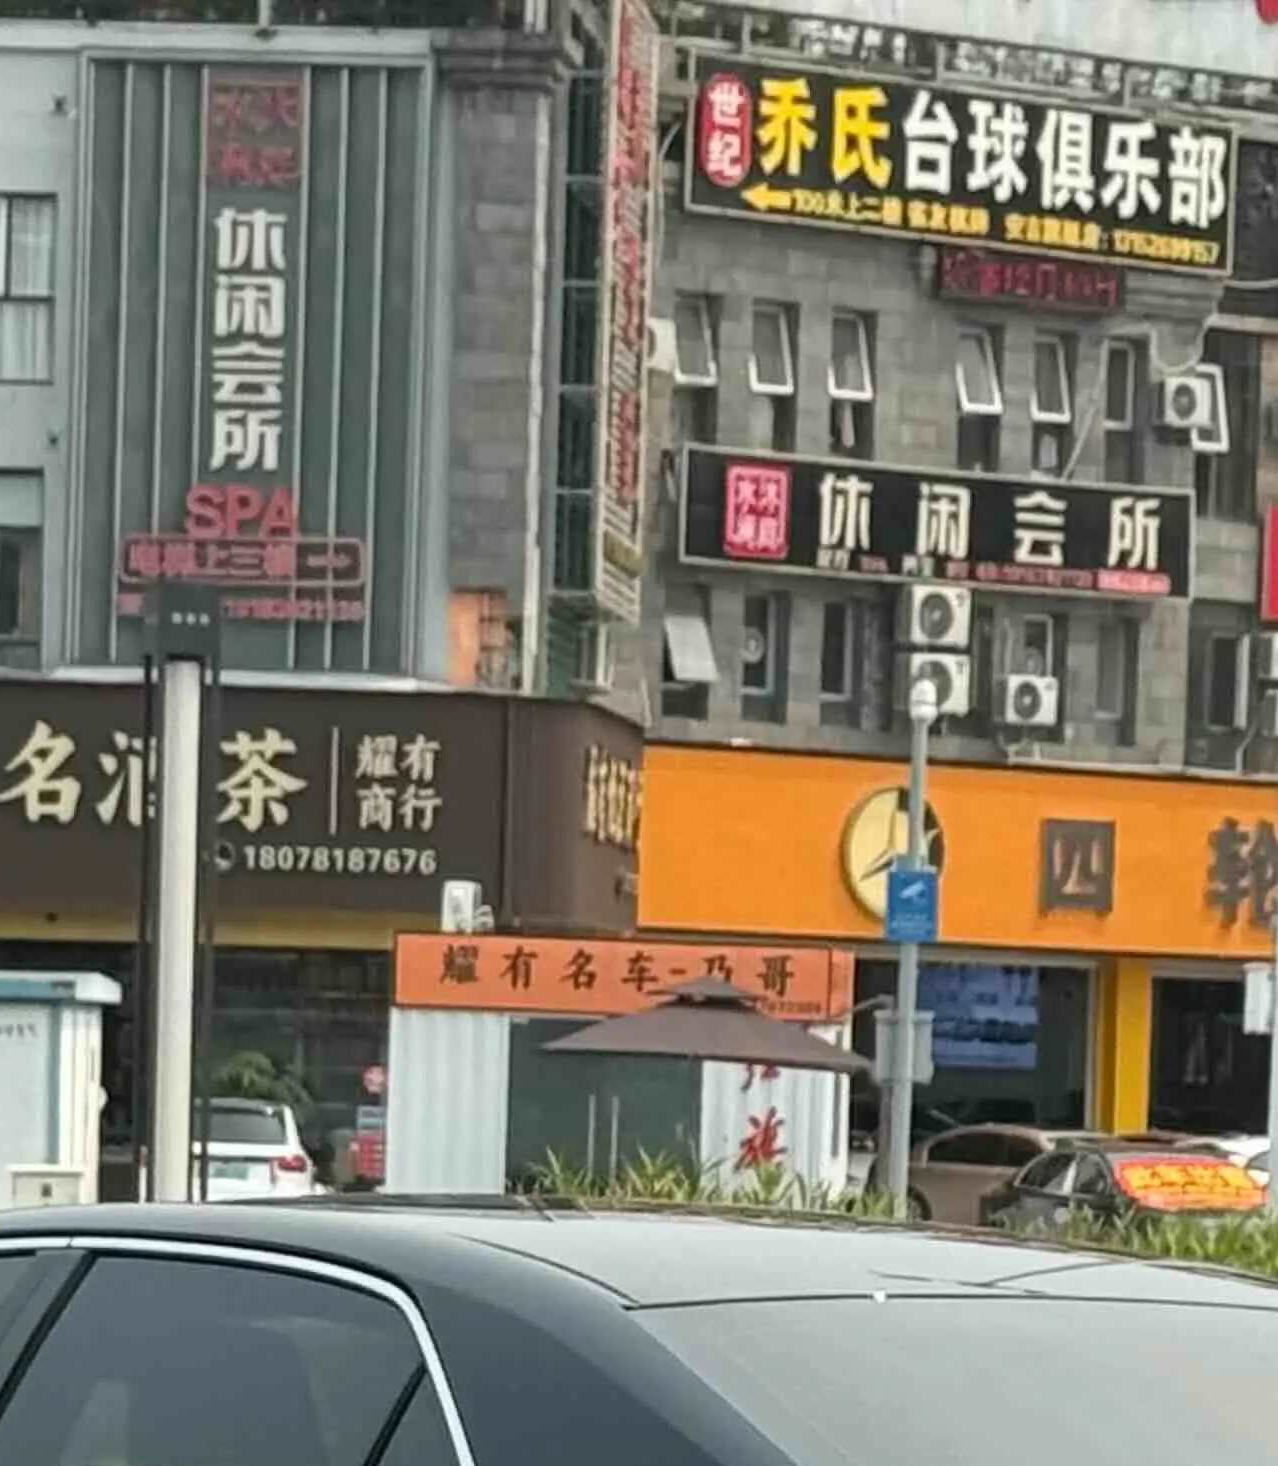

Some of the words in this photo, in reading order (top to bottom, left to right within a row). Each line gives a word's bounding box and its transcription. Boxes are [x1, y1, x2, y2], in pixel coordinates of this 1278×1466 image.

[210, 207, 287, 472] 休闲会所
[184, 484, 299, 538] SPA
[819, 472, 1162, 571] 休闲会所
[356, 782, 443, 832] 商行
[244, 844, 438, 875] 18078187676
